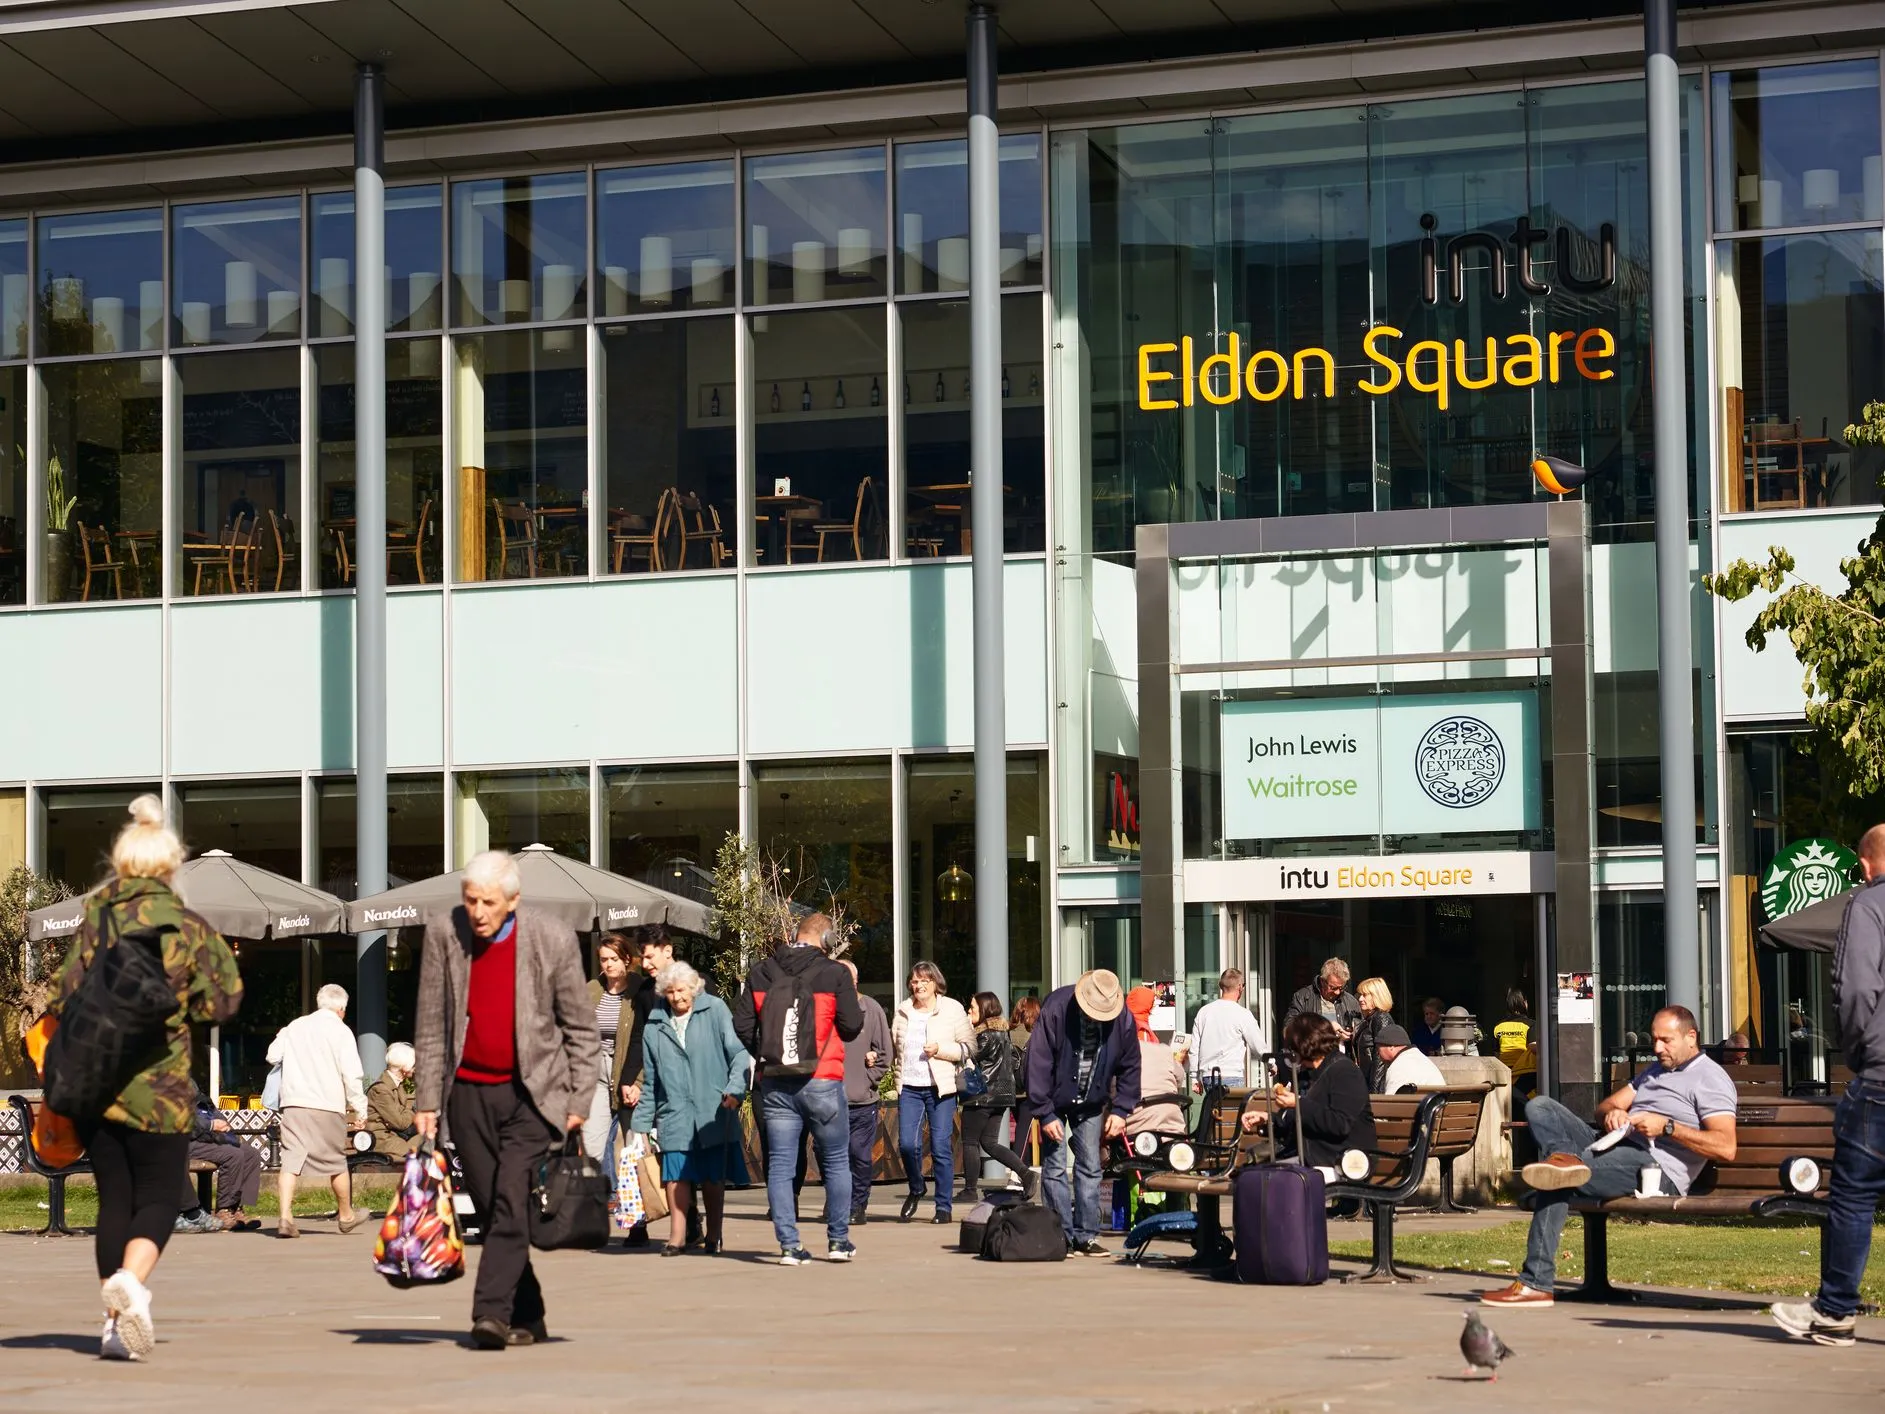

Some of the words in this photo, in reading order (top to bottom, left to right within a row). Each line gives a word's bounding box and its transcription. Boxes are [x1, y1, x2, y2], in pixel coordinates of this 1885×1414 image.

[1418, 211, 1617, 306] intu
[1138, 331, 1337, 412] Eldon
[1357, 325, 1616, 411] Square
[1247, 736, 1295, 763] John
[1300, 733, 1357, 755] Lewis
[1438, 748, 1484, 760] PIZZA
[1426, 759, 1495, 772] EXPRESS
[1247, 774, 1358, 799] Waitrose
[1280, 865, 1329, 890] intu
[1337, 865, 1395, 889] Eldon
[1400, 864, 1473, 892] Square
[278, 914, 310, 930] Nando's
[363, 905, 417, 923] Nando's
[607, 905, 639, 921] Nando's
